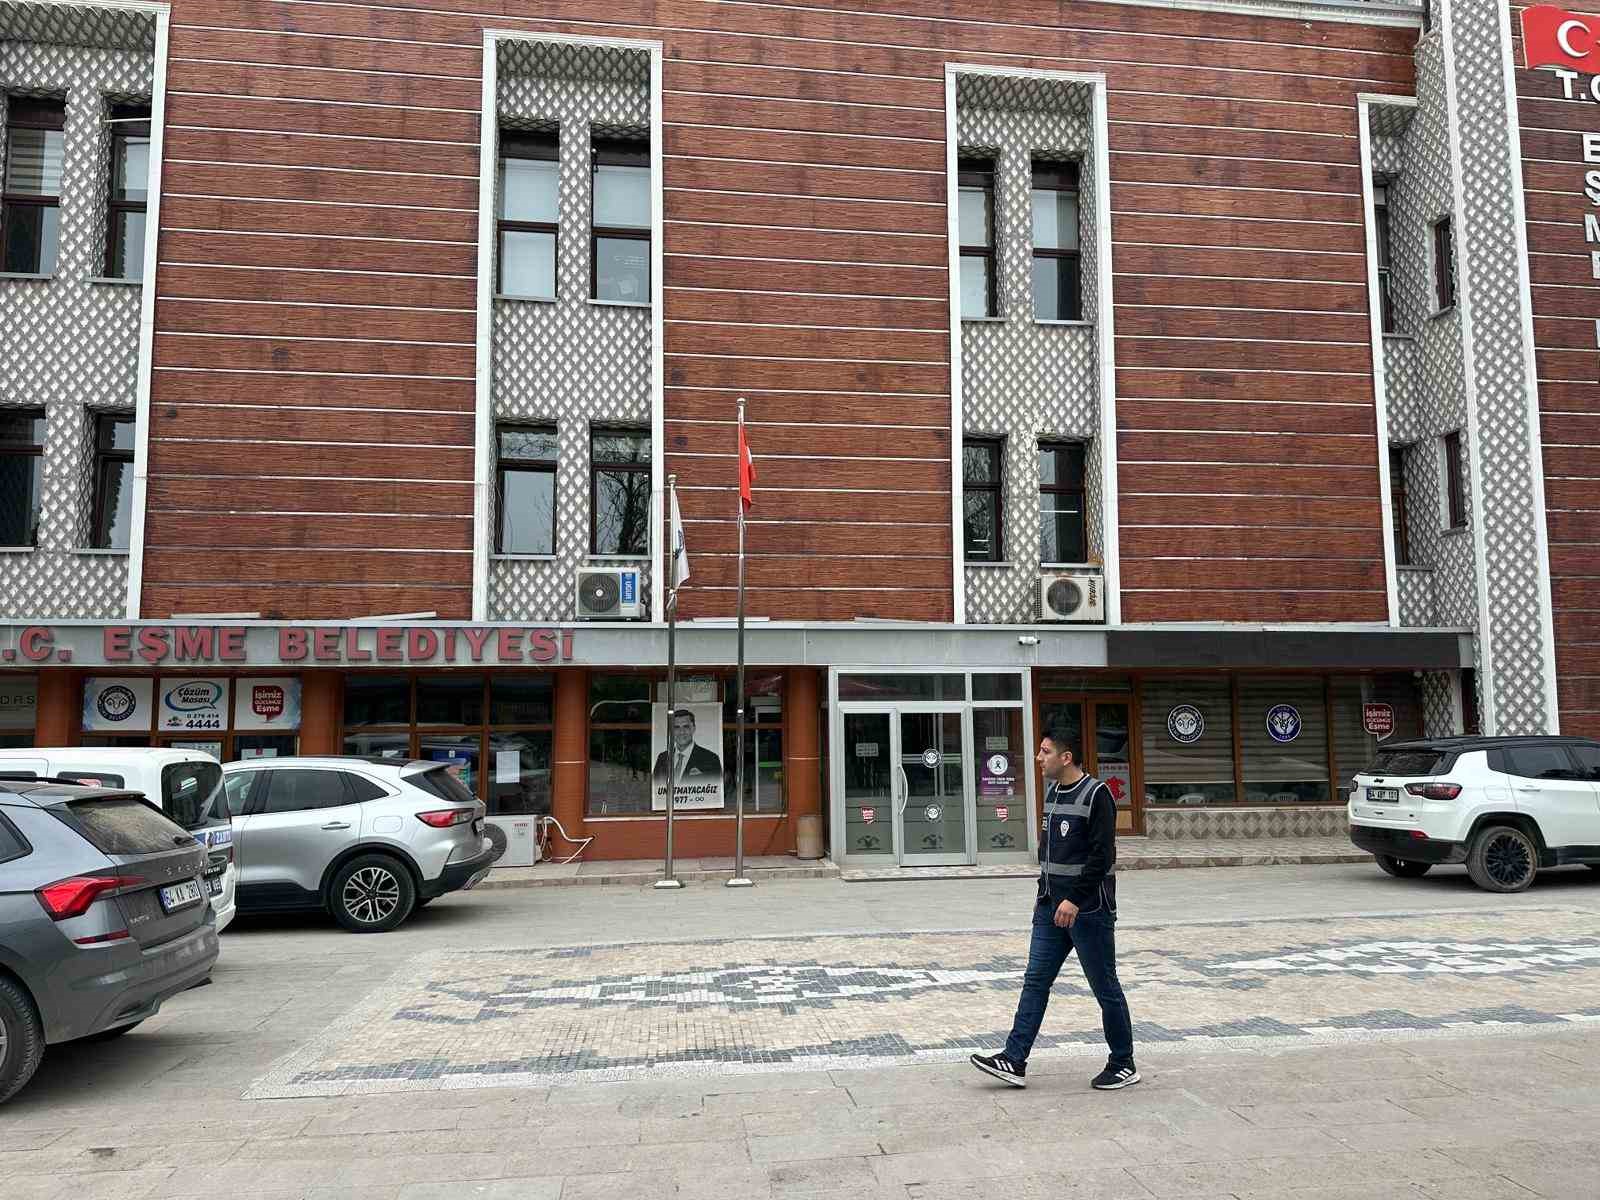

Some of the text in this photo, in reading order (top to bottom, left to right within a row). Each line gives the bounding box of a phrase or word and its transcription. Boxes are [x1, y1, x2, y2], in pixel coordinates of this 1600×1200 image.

[103, 626, 247, 664] EŞME
[279, 626, 574, 661] BELEDİYESİ
[177, 687, 210, 697] Çözüm
[186, 719, 220, 729] 4444
[657, 783, 719, 795] UNTMAYACAĞIZ
